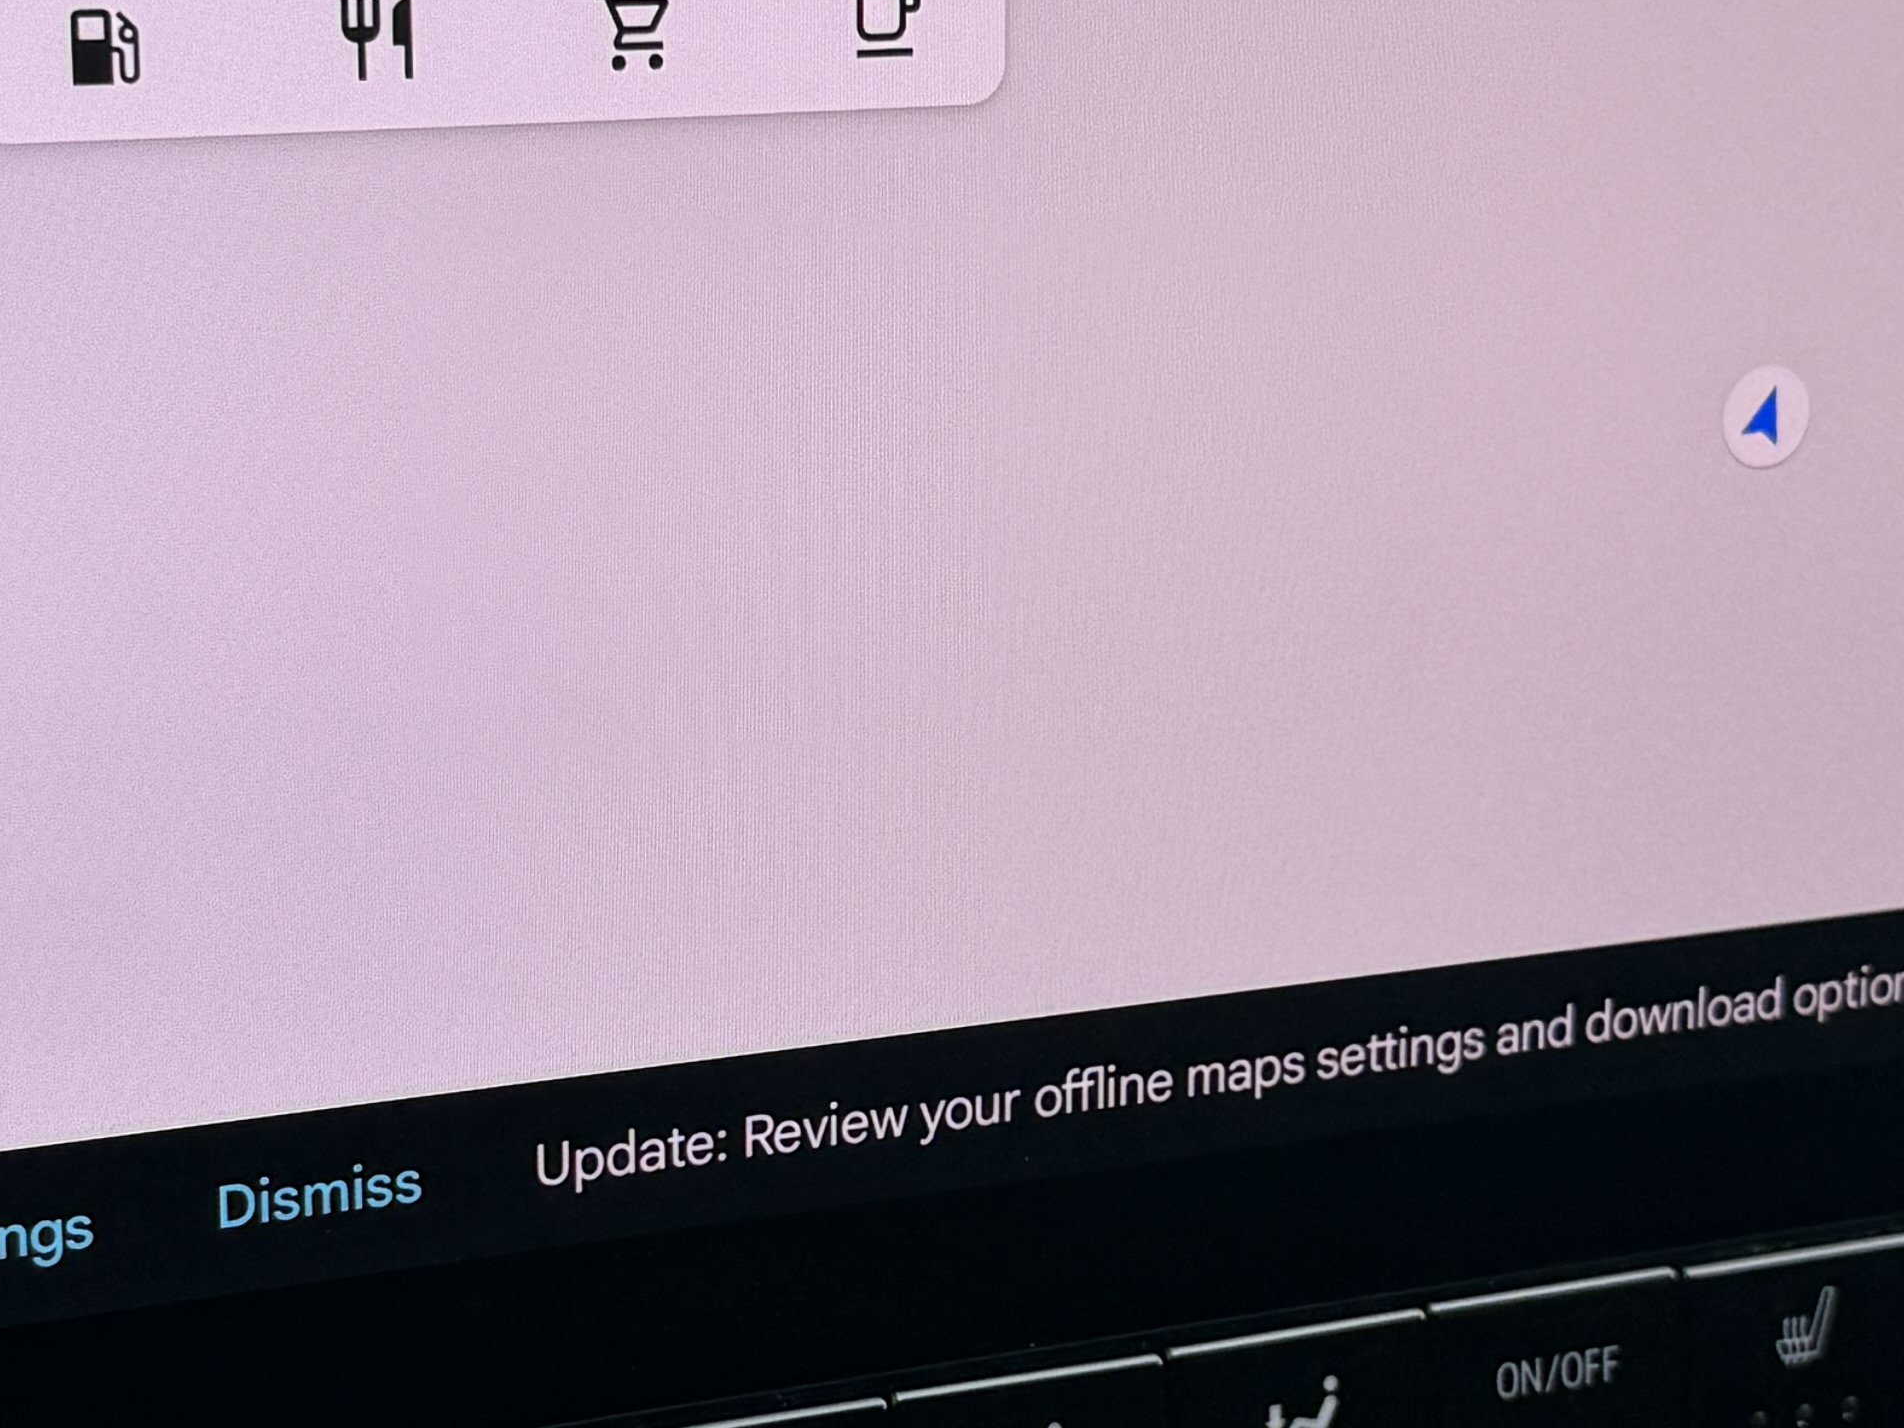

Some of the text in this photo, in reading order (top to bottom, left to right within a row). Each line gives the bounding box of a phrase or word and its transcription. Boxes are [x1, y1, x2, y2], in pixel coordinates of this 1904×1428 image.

[534, 1127, 729, 1190] Update:
[744, 1100, 910, 1159] Review
[918, 1088, 1022, 1147] your
[1033, 1063, 1175, 1119] offline
[1186, 1050, 1307, 1101] maps
[1315, 1024, 1486, 1076] settings
[1495, 1002, 1575, 1056] and
[1584, 975, 1784, 1044] download
[216, 1164, 422, 1230] Dismiss
[1495, 1343, 1620, 1400] ON/OFF
